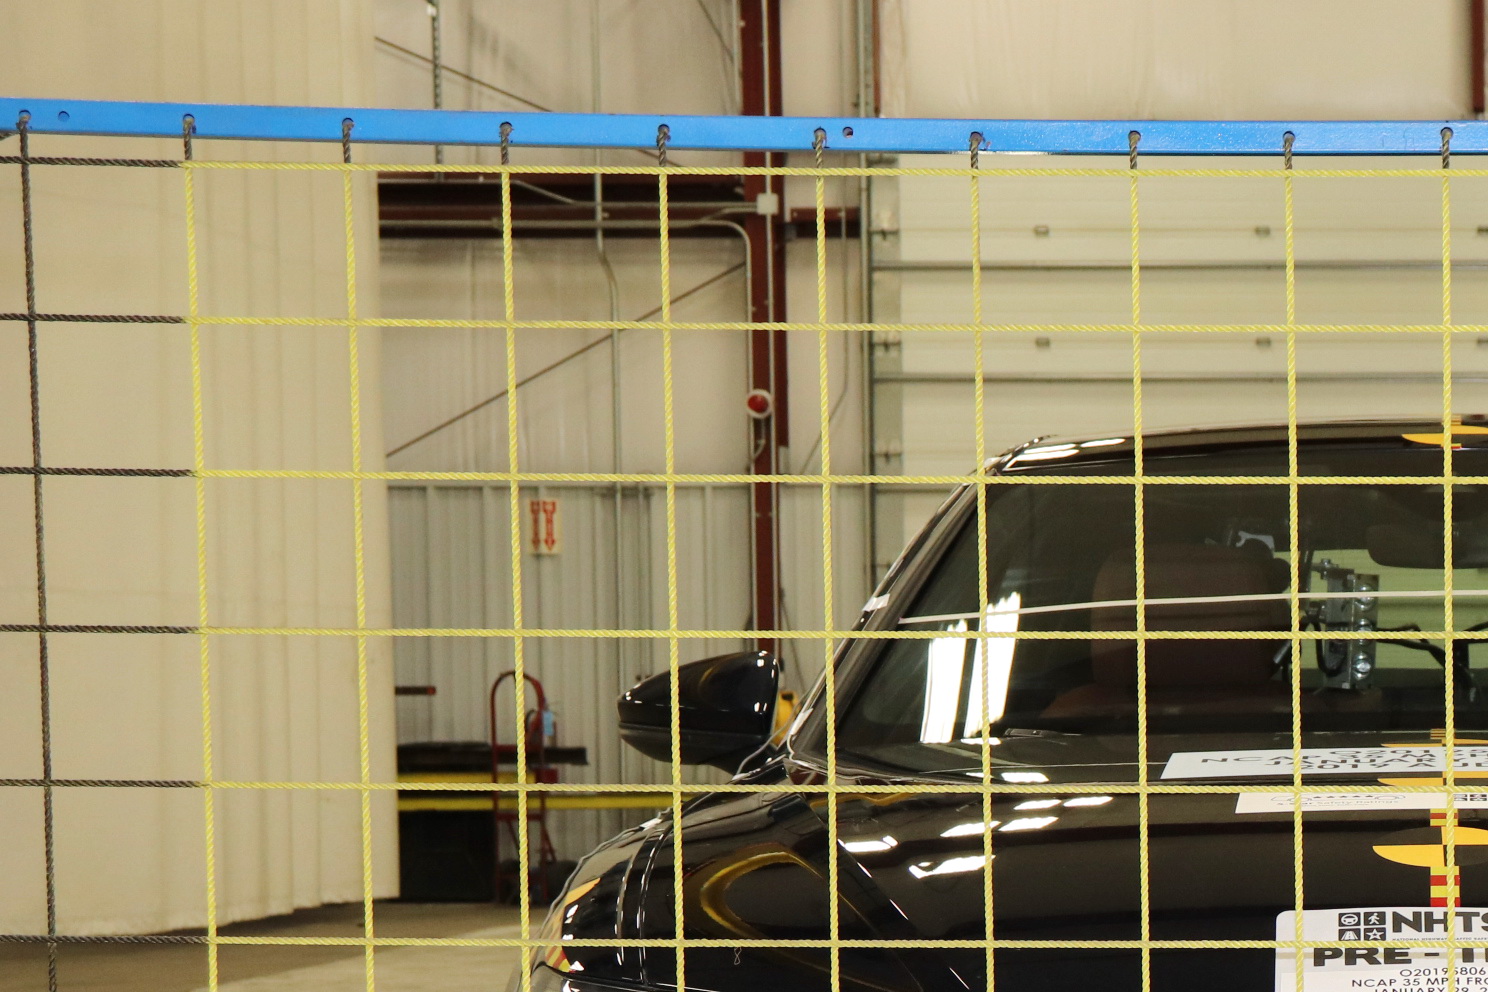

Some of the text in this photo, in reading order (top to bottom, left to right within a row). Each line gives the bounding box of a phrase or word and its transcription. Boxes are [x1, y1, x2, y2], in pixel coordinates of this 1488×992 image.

[1201, 755, 1321, 763] NCAP
[1266, 757, 1466, 766] JANUARY
[1313, 946, 1412, 967] PRE
[1352, 978, 1397, 987] NCAP
[1403, 978, 1421, 987] 35
[1426, 977, 1460, 986] MPH
